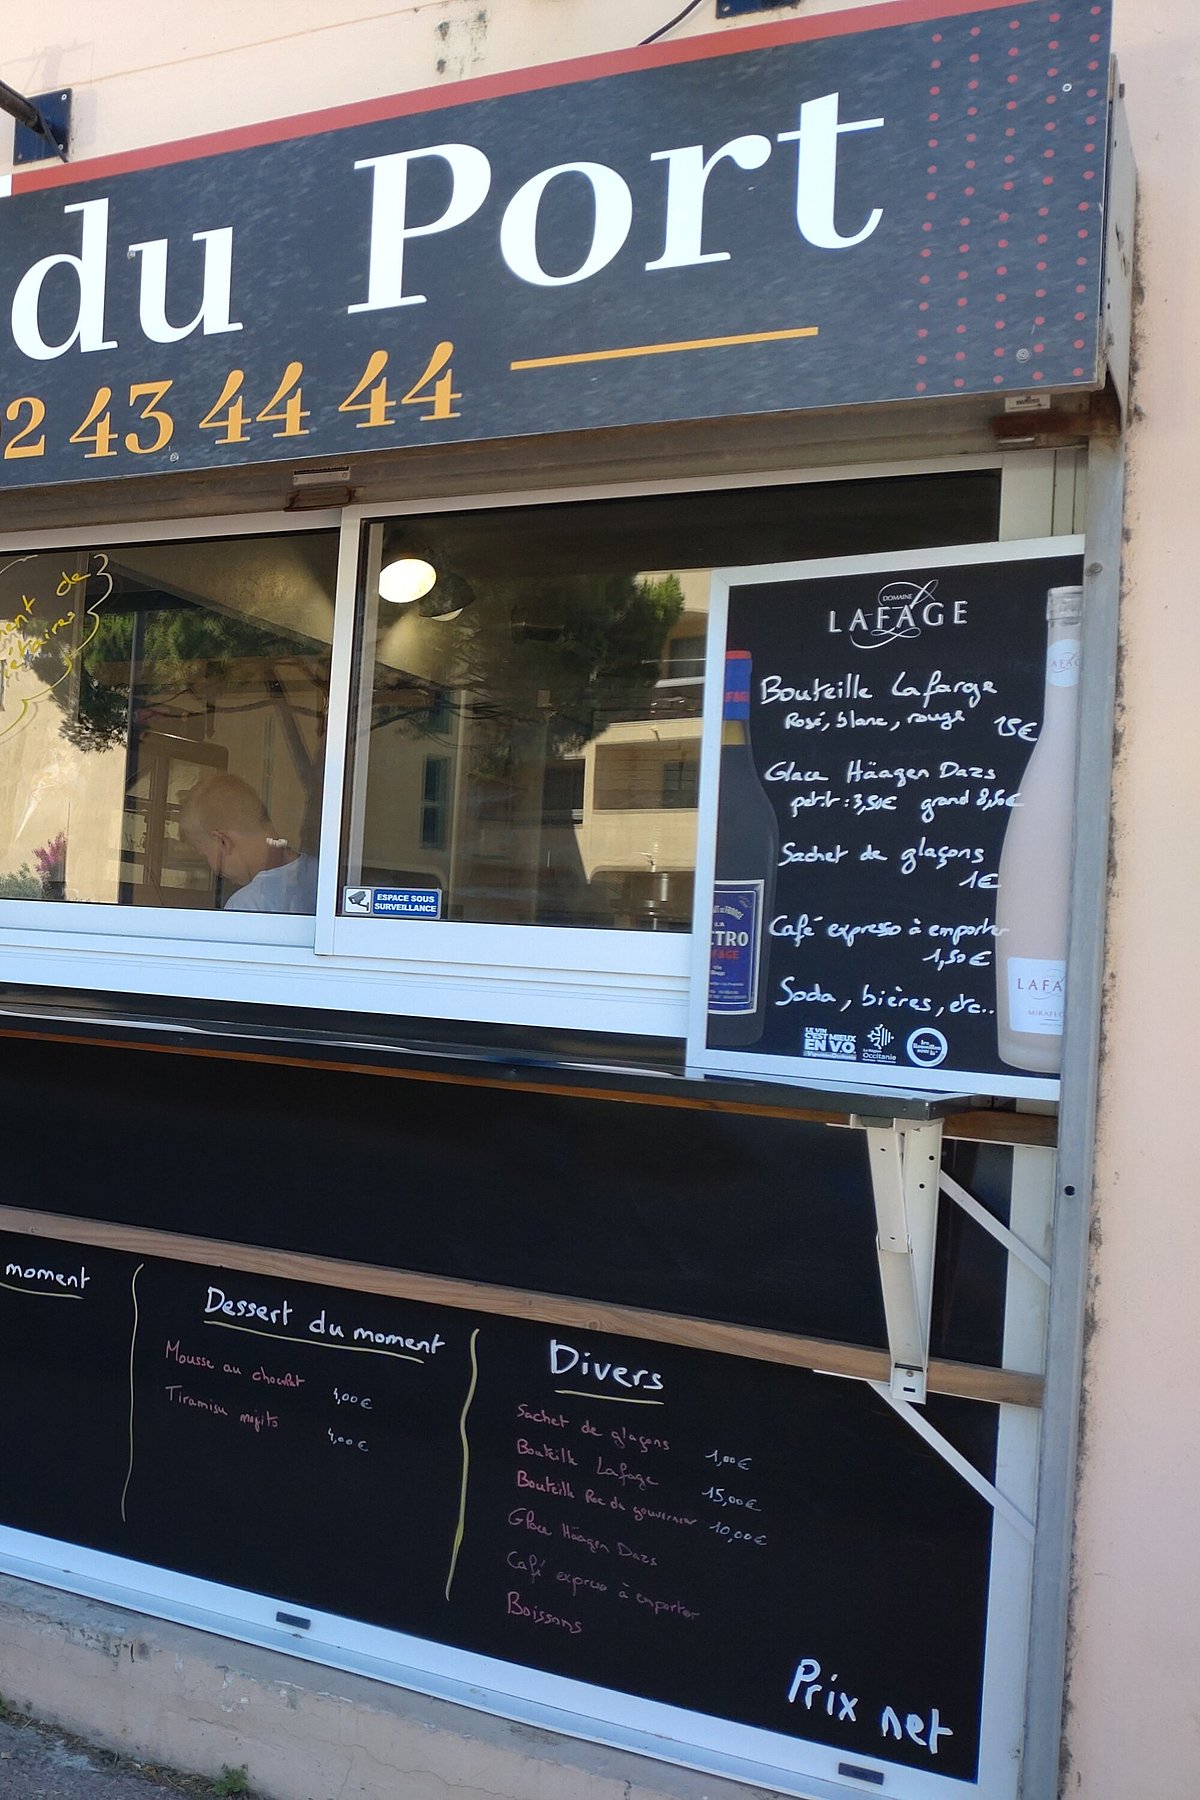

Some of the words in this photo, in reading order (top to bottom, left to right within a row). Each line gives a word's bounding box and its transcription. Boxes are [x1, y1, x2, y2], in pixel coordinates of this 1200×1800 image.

[11, 198, 243, 361] du
[347, 91, 885, 314] Port
[69, 379, 175, 459] 43
[200, 361, 311, 444] 44
[338, 341, 462, 429] 44
[882, 593, 913, 602] DOMAINE
[828, 601, 968, 634] LAFAGE
[761, 673, 873, 704] Bouteille
[892, 670, 998, 708] Lafarge
[907, 709, 966, 731] rouge
[994, 715, 1038, 742] 15€
[764, 761, 829, 782] Glace
[847, 759, 930, 787] Häagen
[939, 761, 997, 780] Dazs
[921, 789, 970, 823] grand
[778, 842, 849, 866] Sachet
[860, 844, 888, 862] de
[901, 836, 985, 875] glaçons
[959, 870, 1002, 889] 1€
[374, 903, 437, 912] SURVEILLANCE
[377, 893, 409, 902] ESPACE
[410, 895, 435, 903] SOUS
[711, 930, 749, 947] TRO
[768, 914, 824, 947] Café
[827, 920, 902, 947] expresso
[908, 917, 922, 936] à
[928, 917, 1010, 945] emporter
[1017, 978, 1062, 991] LAFA
[804, 1039, 827, 1051] EN
[829, 1040, 857, 1054] V.O.
[829, 1034, 856, 1042] MIEUX
[6, 1265, 91, 1290] moment
[204, 1286, 293, 1327] Dessert
[309, 1310, 344, 1339] du
[353, 1328, 446, 1356] moment
[165, 1340, 215, 1369] Mousse
[223, 1363, 242, 1375] au
[252, 1366, 306, 1388] chocolat
[549, 1338, 664, 1391] Divers
[165, 1385, 228, 1416] Tiramisu
[517, 1403, 570, 1428] Sachet
[581, 1420, 603, 1437] de
[611, 1427, 671, 1453] glaçons
[517, 1438, 579, 1466] Bouteille
[597, 1456, 659, 1490] Lafage
[517, 1470, 575, 1499] Bouteille
[508, 1508, 552, 1536] Glace
[617, 1542, 658, 1567] Dazs
[618, 1582, 629, 1599] à
[507, 1591, 583, 1634] Boissons
[788, 1658, 859, 1722] Prix
[881, 1705, 954, 1755] net
